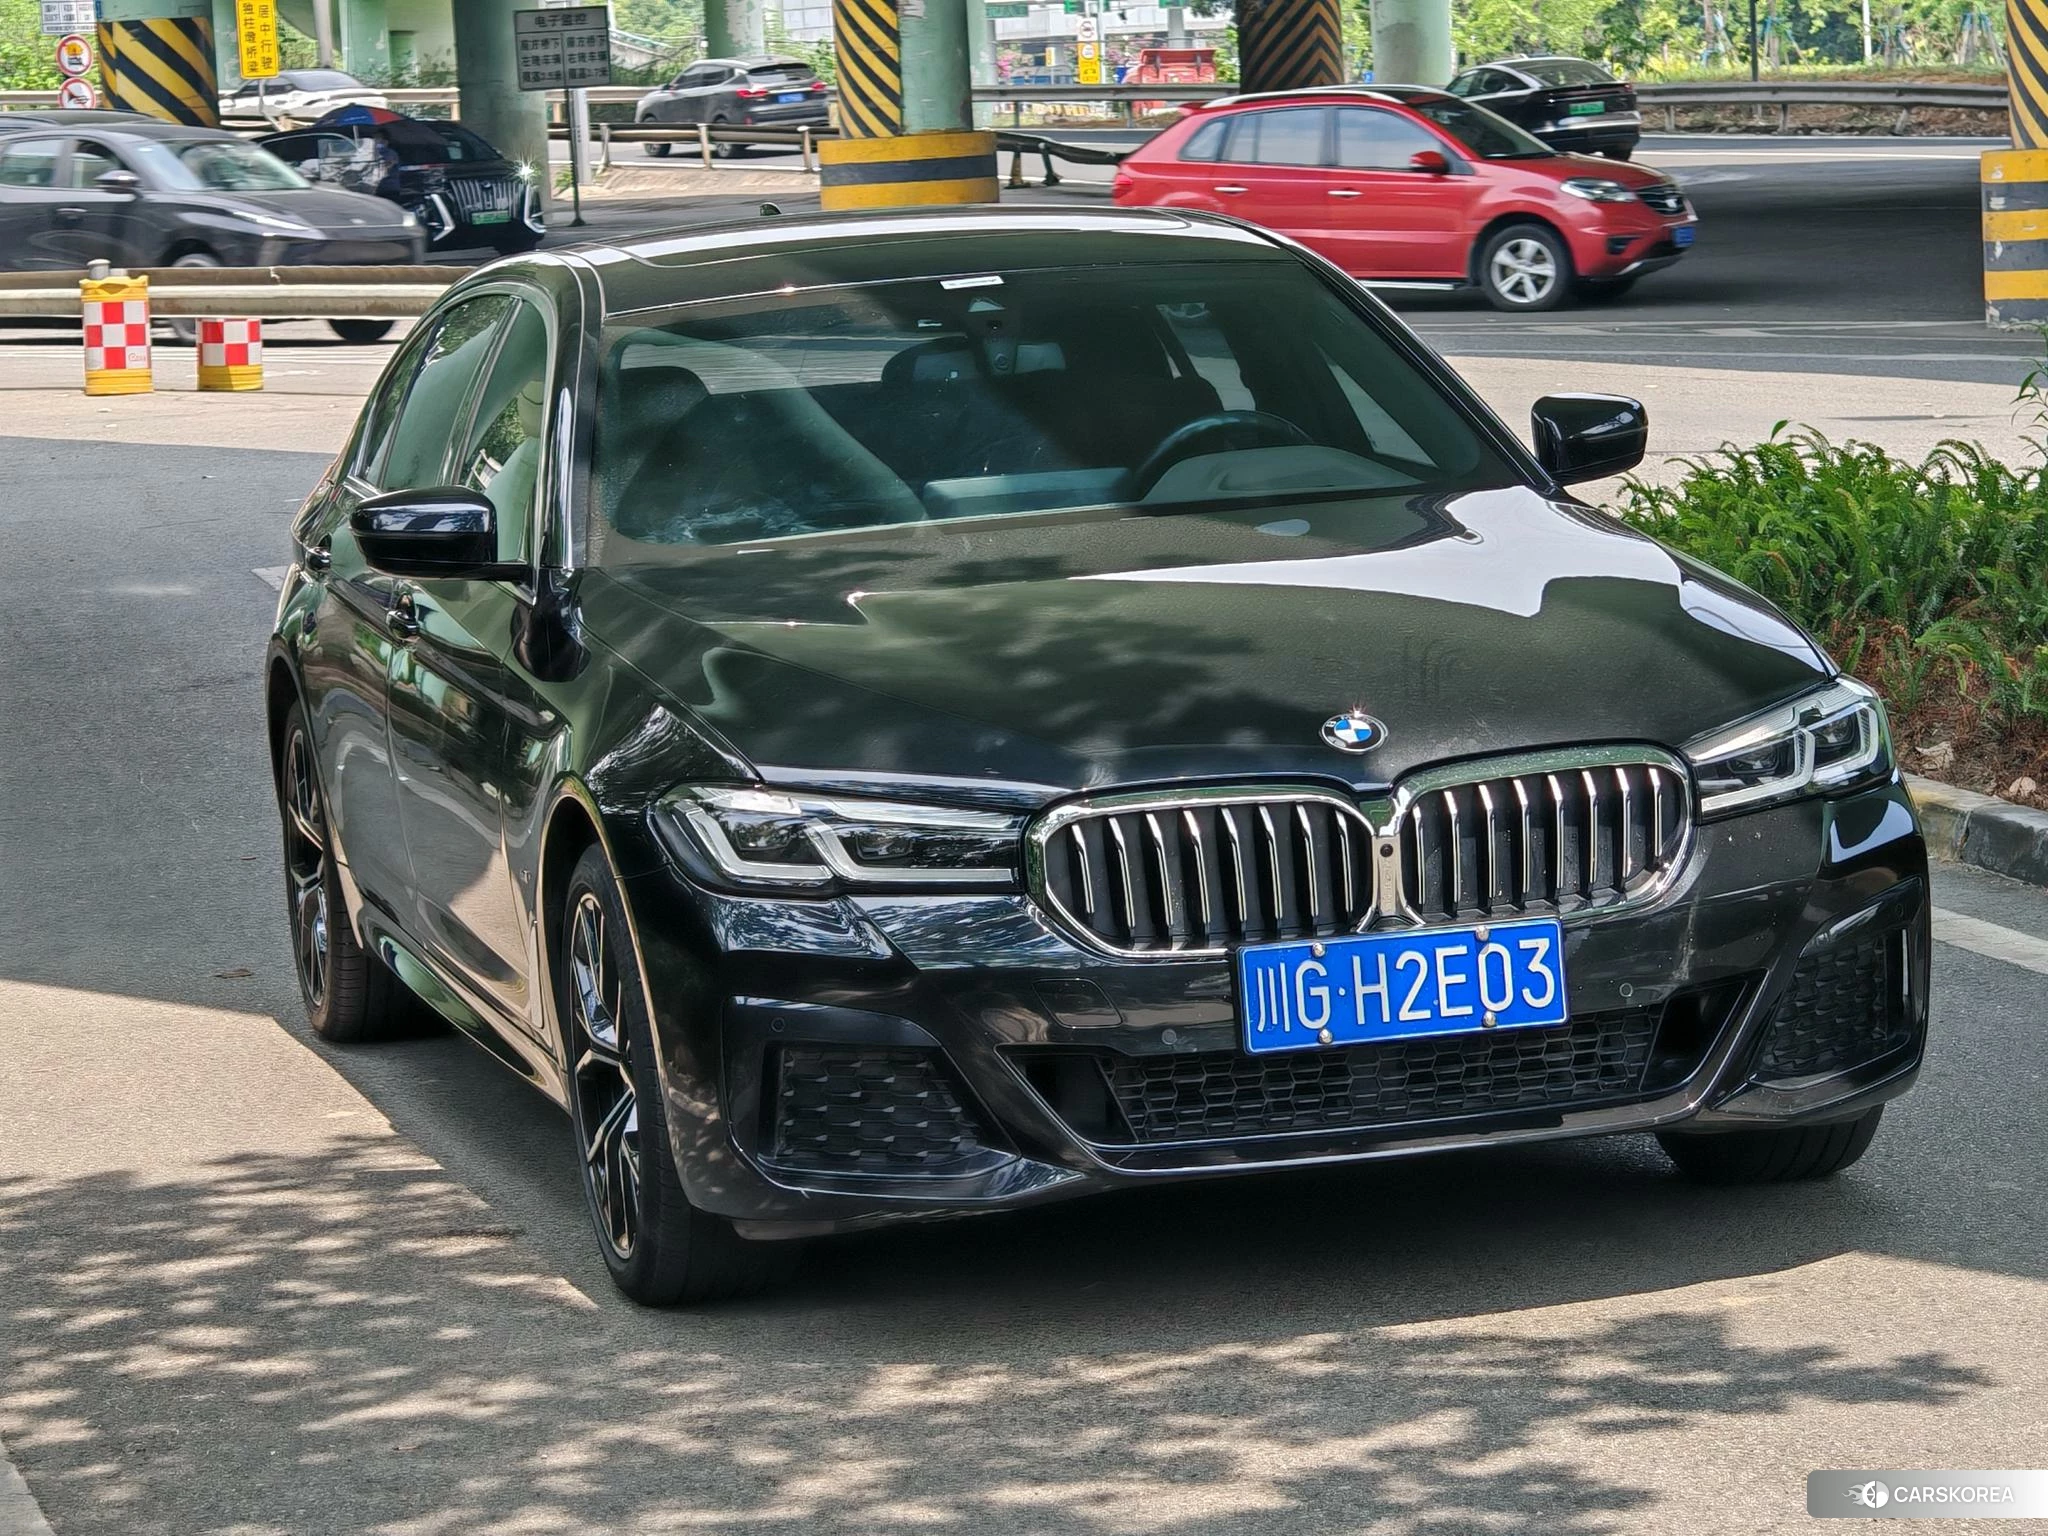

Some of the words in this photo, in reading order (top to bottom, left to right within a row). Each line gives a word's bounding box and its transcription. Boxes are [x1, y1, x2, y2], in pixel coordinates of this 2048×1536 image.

[259, 4, 273, 70] 居中行驶
[534, 12, 589, 28] 电子监控
